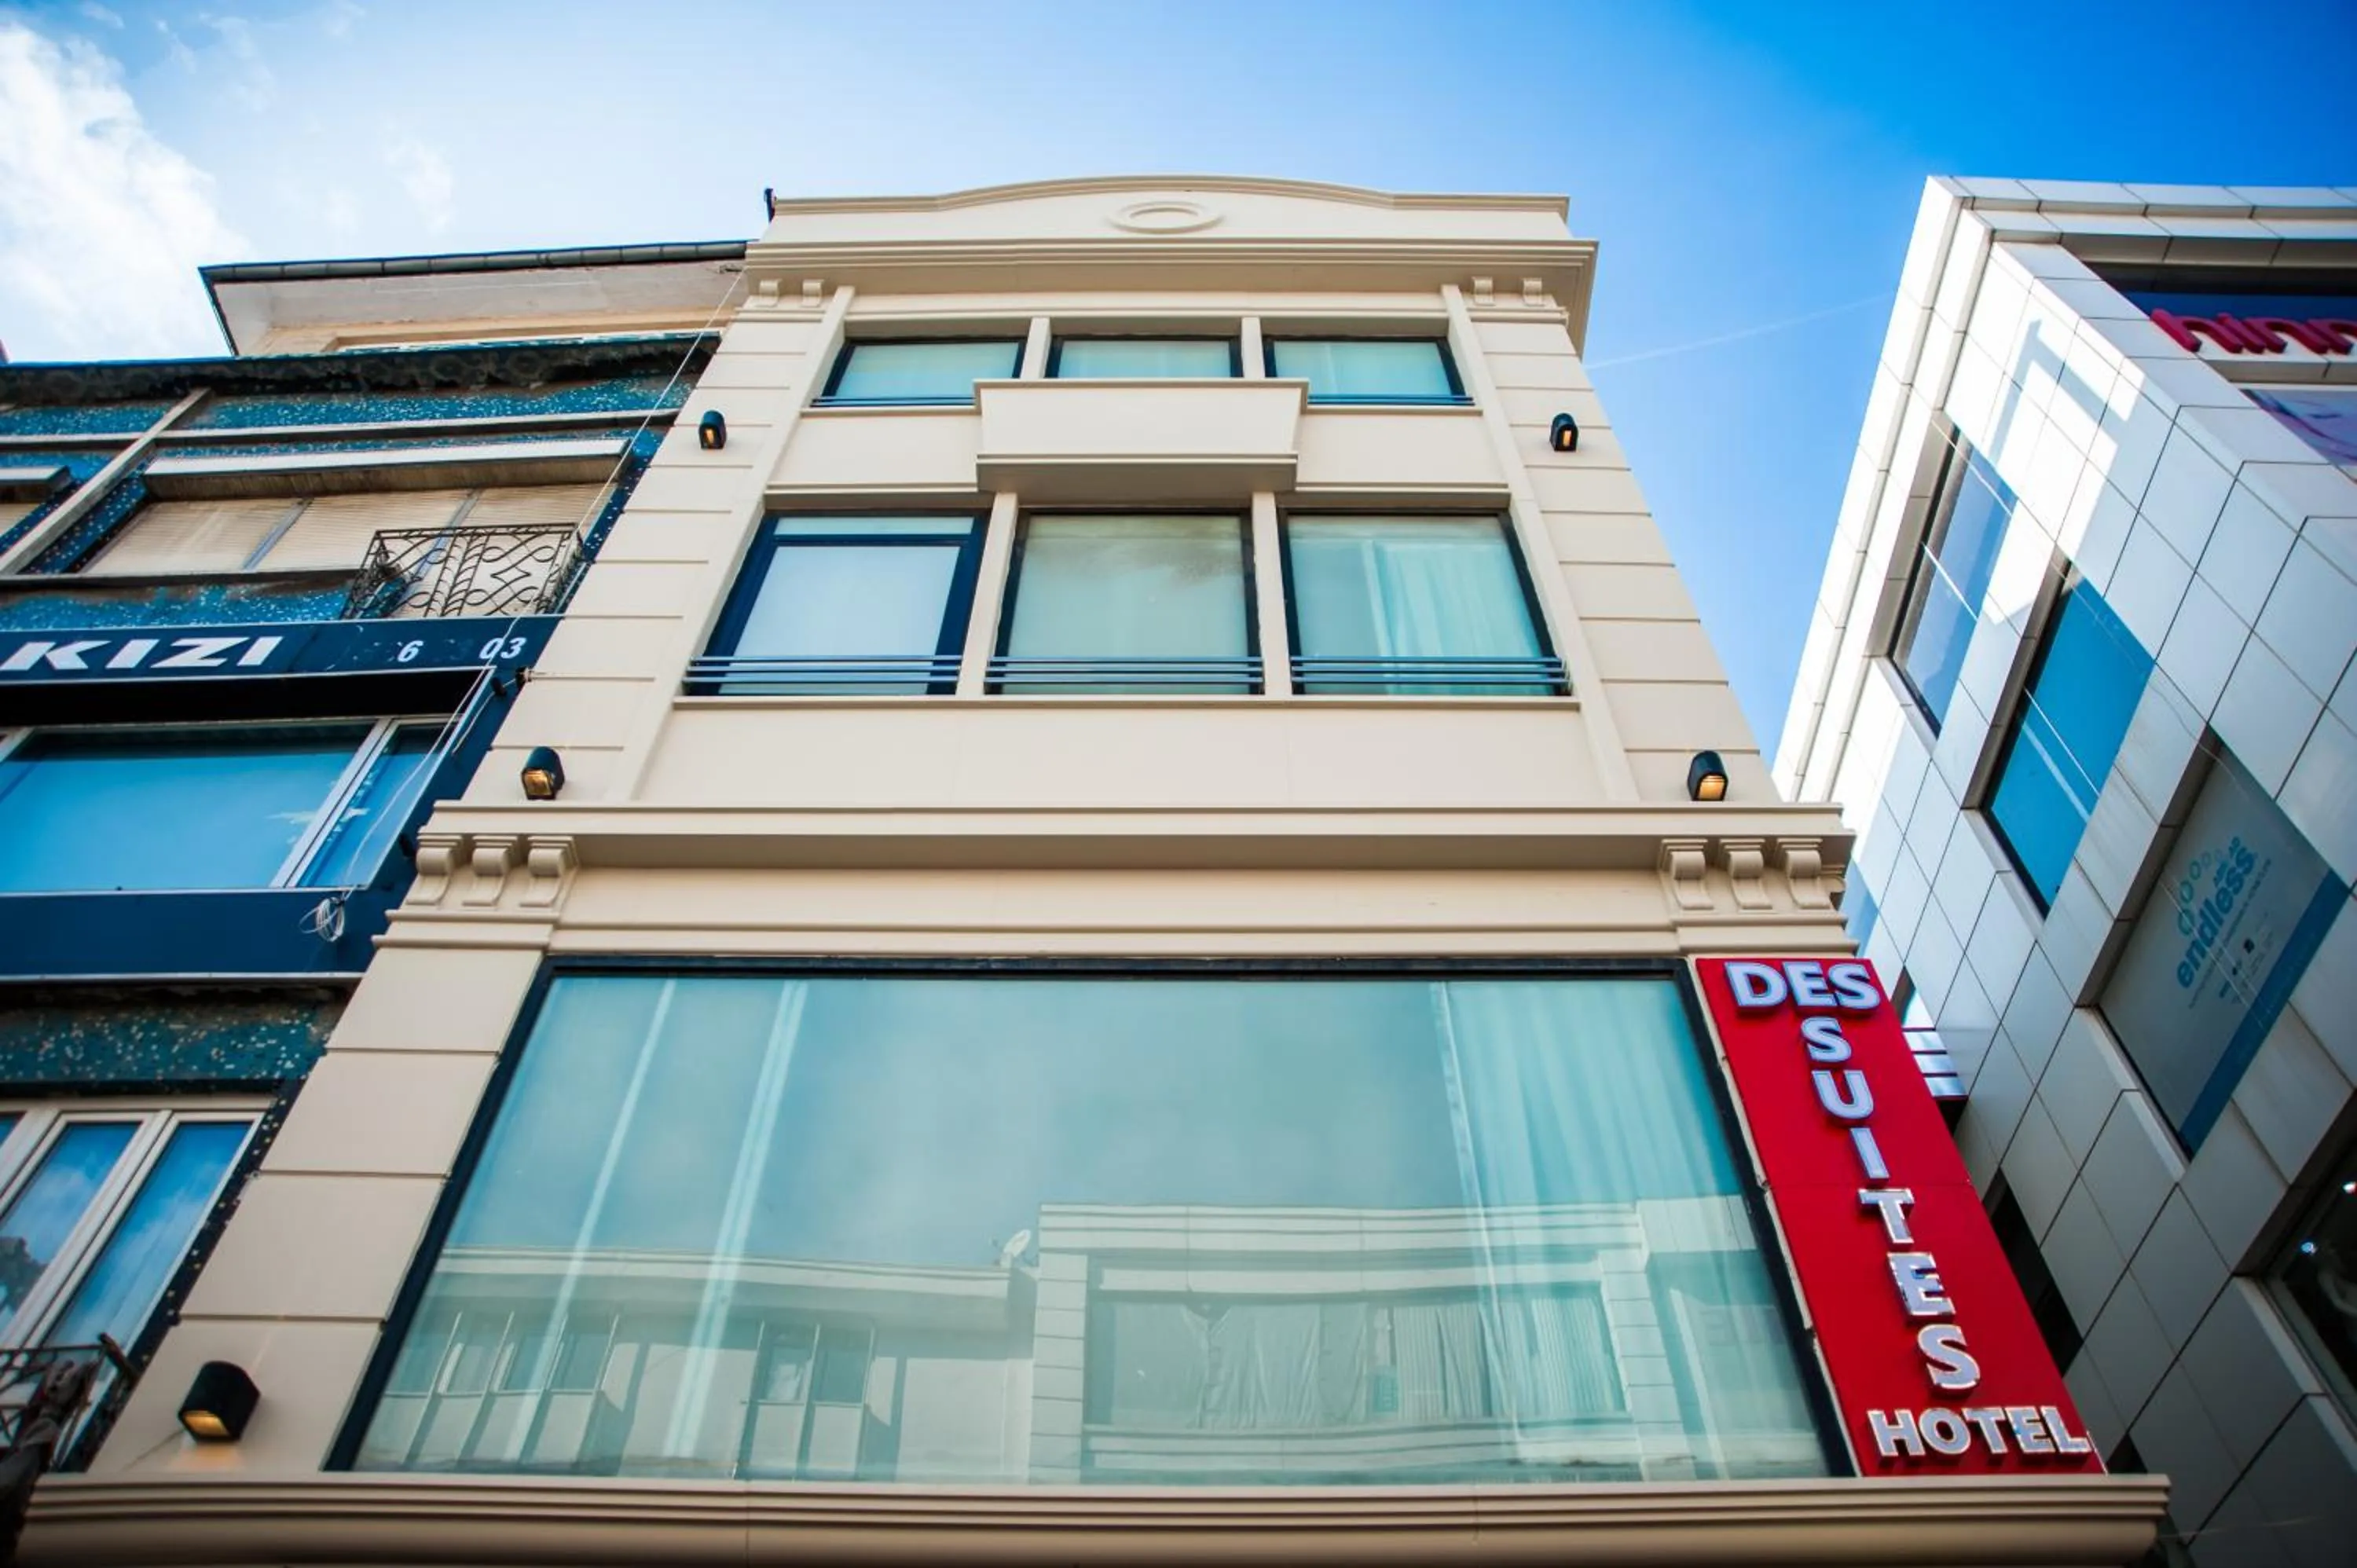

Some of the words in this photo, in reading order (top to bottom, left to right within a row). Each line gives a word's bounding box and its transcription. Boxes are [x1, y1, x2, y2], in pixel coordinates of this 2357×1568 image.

[0, 636, 284, 671] KIZI
[2176, 846, 2255, 988] endless
[1723, 961, 1881, 1011] DES
[1801, 1016, 1981, 1390] SUITES
[1866, 1405, 2091, 1458] HOTEL
